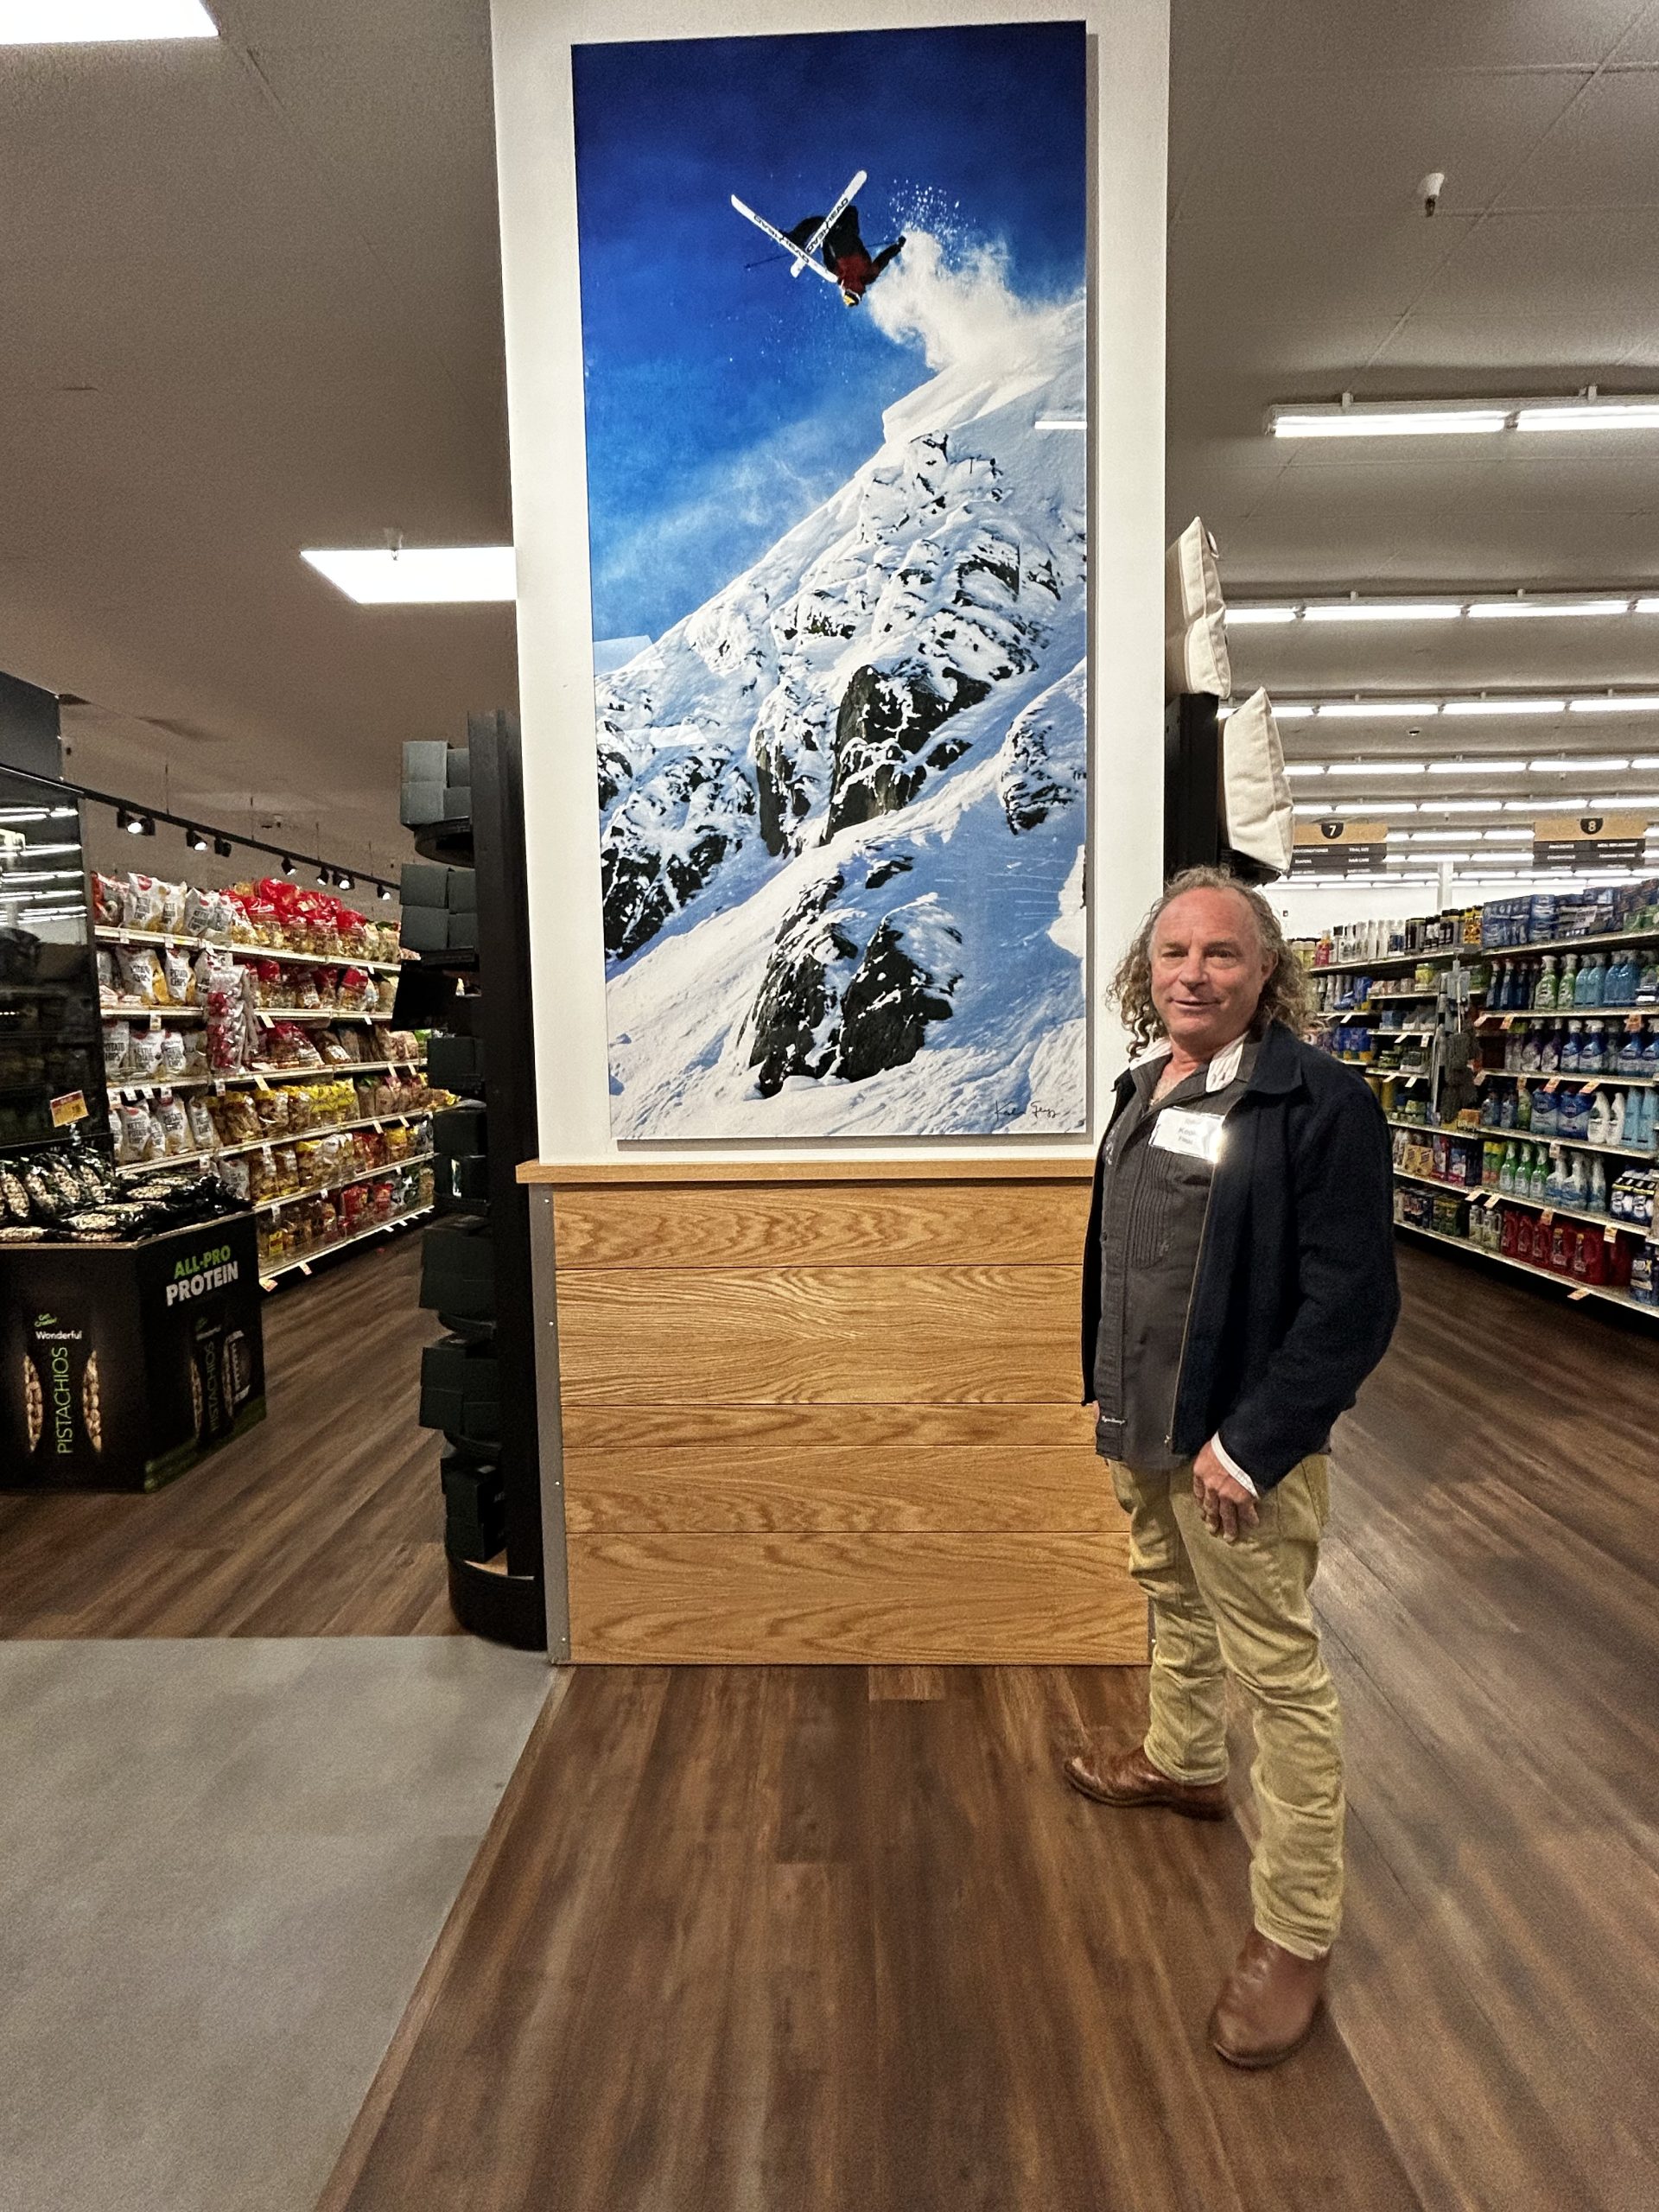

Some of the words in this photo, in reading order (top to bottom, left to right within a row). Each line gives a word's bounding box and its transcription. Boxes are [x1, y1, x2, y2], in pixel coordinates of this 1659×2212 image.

[827, 197, 849, 225] HEAD
[1329, 825, 1337, 836] 7
[1588, 821, 1597, 832] 8
[165, 1261, 239, 1306] PROTEIN
[35, 1330, 83, 1340] Wonderful
[51, 1346, 73, 1453] PISTACHIOS
